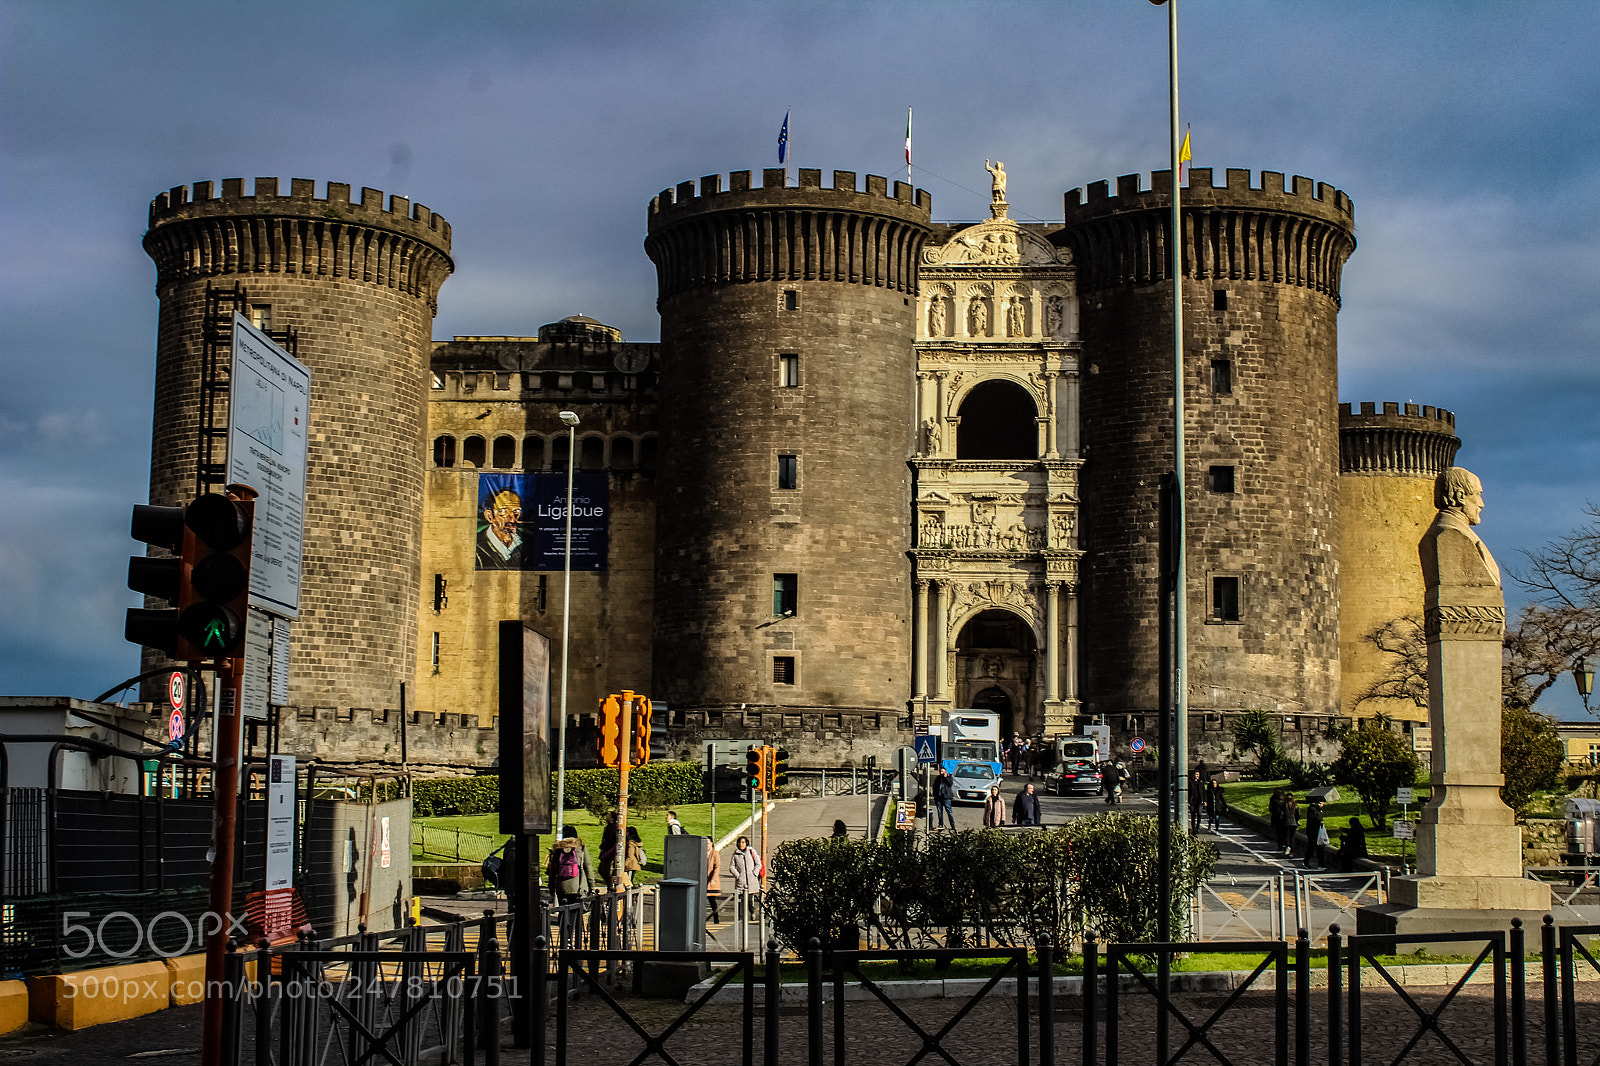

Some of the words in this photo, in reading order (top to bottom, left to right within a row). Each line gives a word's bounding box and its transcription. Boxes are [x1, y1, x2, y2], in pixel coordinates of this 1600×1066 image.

[553, 495, 590, 504] Anonio
[538, 504, 604, 520] Ligabue
[173, 681, 181, 699] 20
